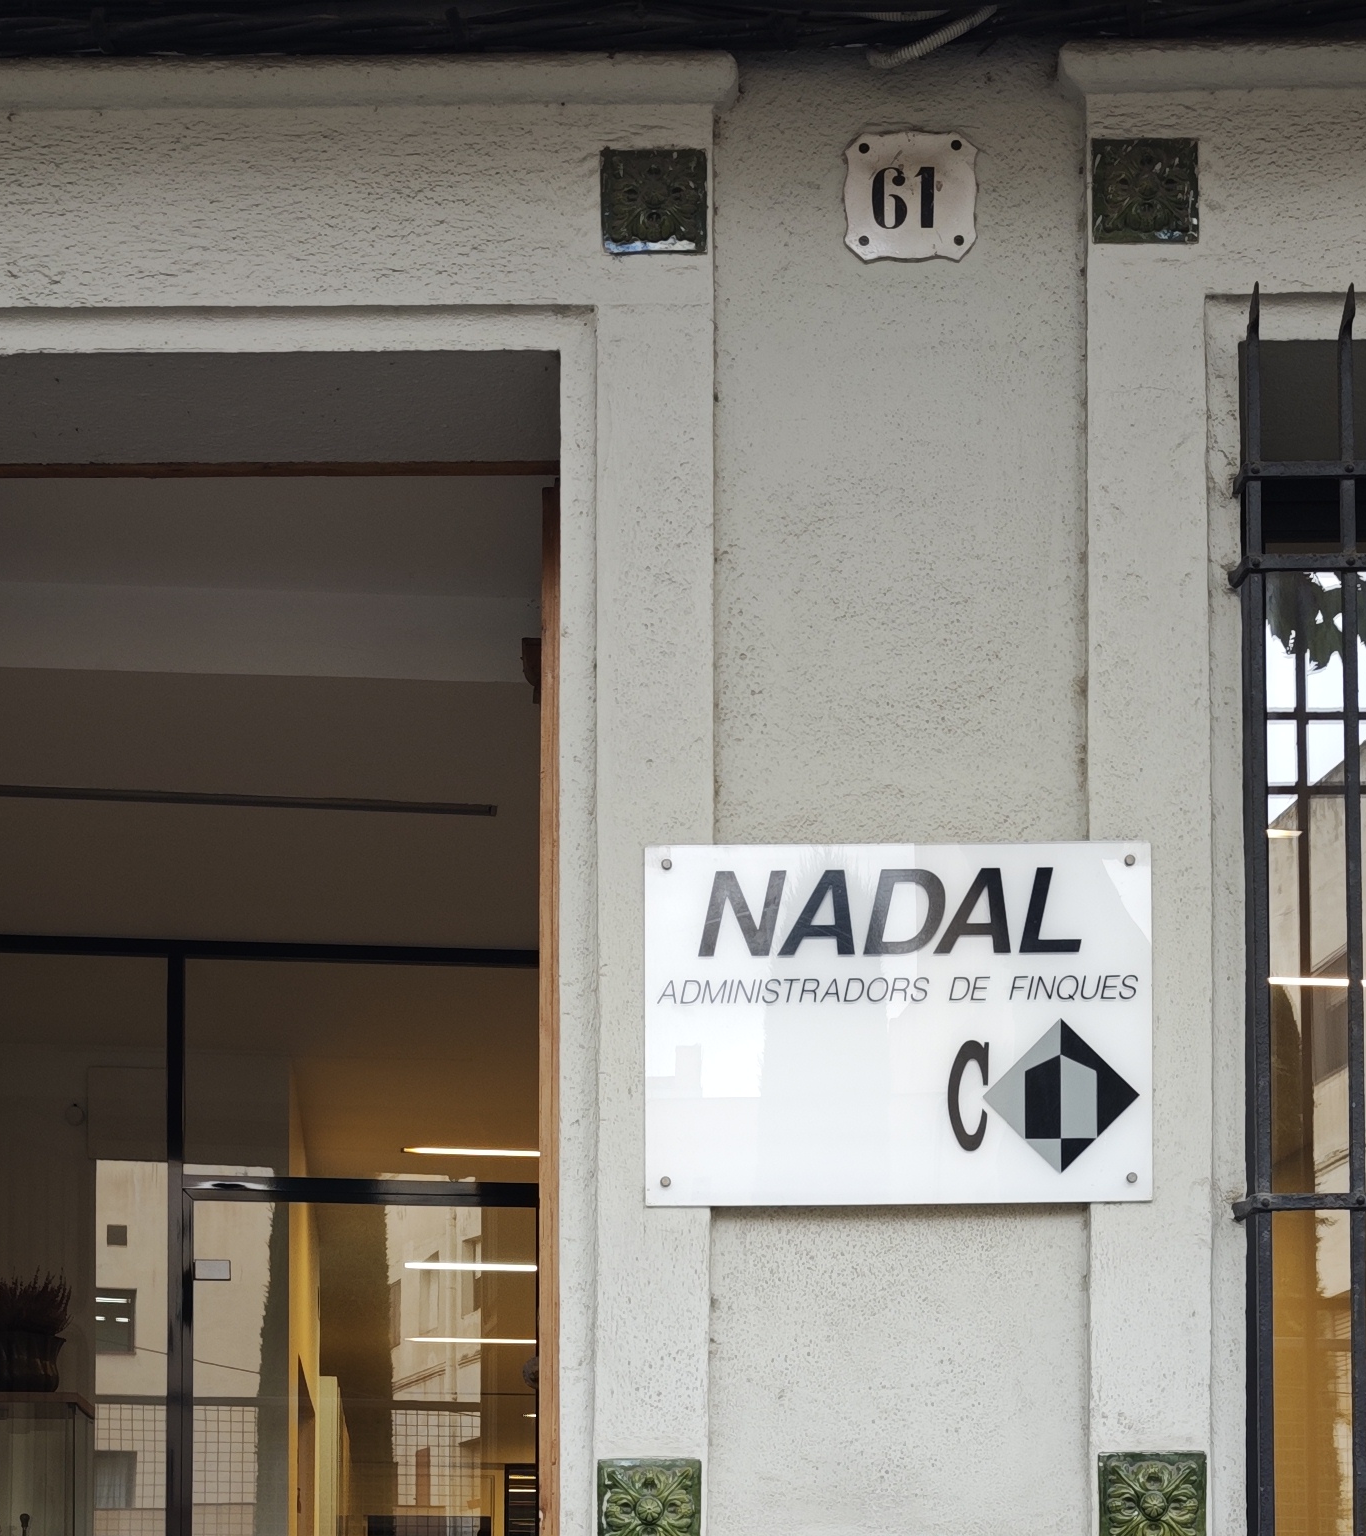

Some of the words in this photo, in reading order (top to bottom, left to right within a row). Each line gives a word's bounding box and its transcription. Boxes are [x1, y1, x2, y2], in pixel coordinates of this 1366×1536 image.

[872, 167, 935, 229] 61
[698, 867, 1082, 957] NADAL
[657, 977, 929, 1004] ADMINISTRADORS
[949, 976, 991, 1002] DE
[1009, 975, 1139, 1002] FINQUES
